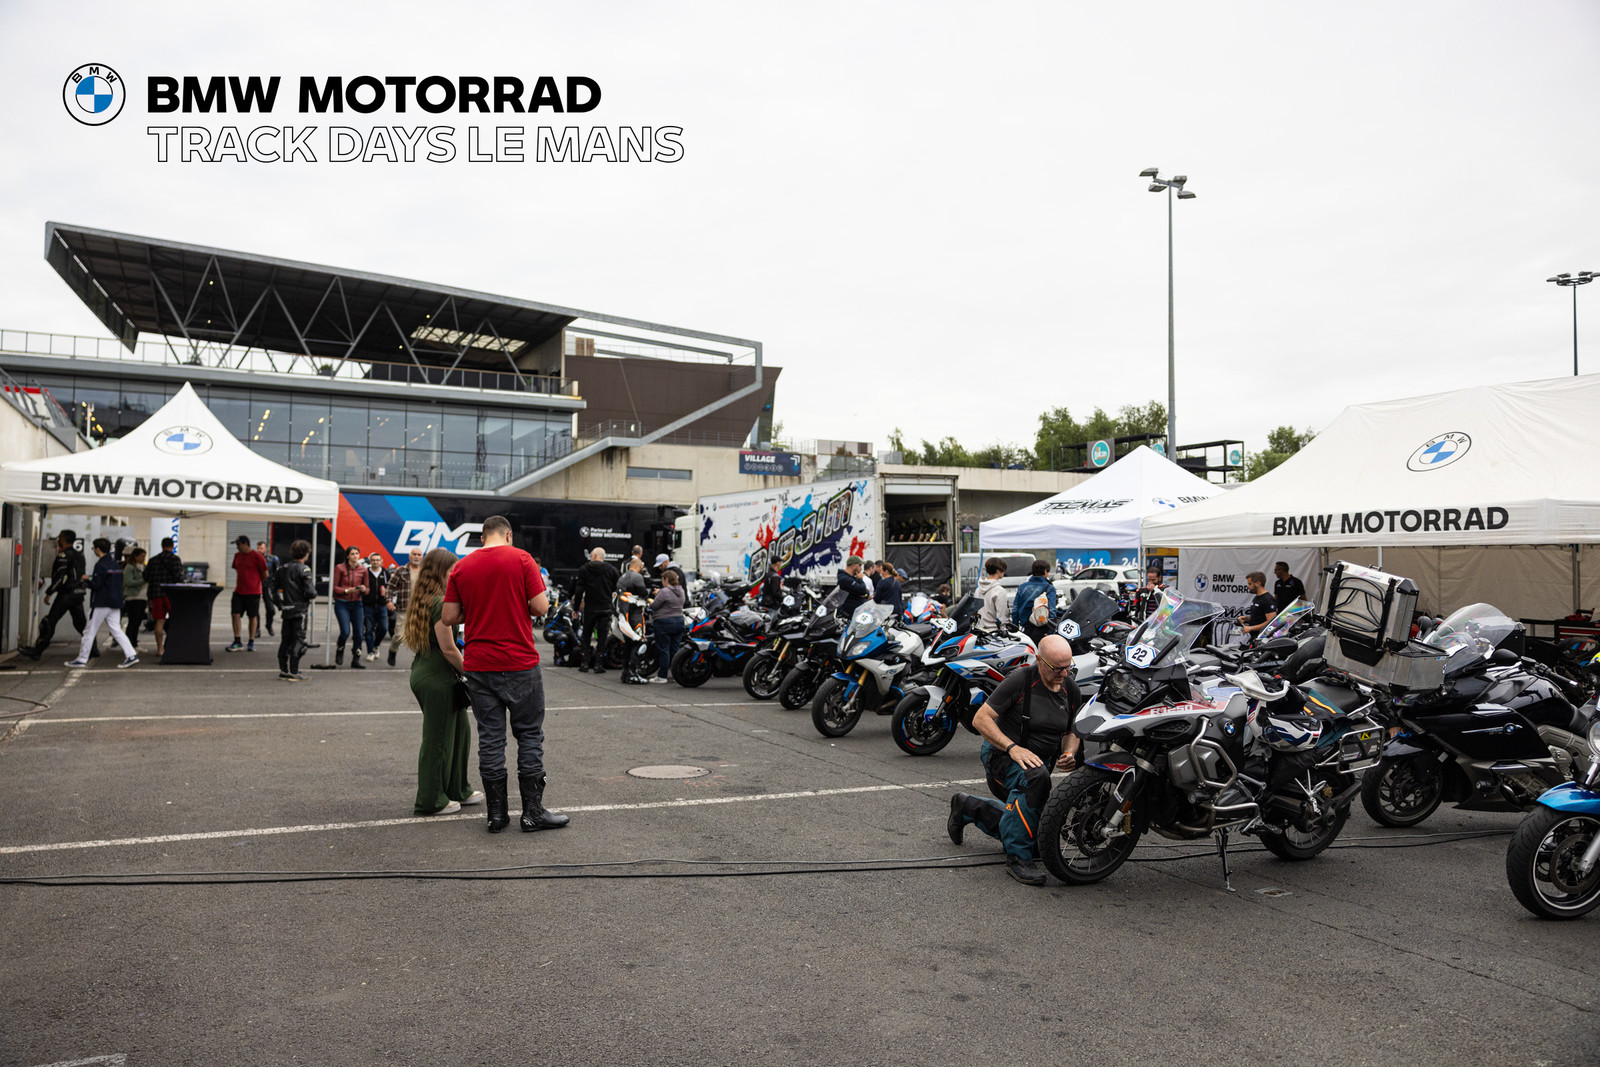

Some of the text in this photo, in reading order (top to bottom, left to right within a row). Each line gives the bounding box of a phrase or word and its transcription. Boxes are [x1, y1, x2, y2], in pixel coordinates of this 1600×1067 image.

[744, 454, 776, 463] VILLAGE
[41, 472, 304, 505] BMW MOTORRAD
[1272, 507, 1509, 537] BMW MOTORRAD
[1212, 574, 1235, 582] BMW
[1062, 623, 1075, 634] 85
[1131, 647, 1148, 663] 22
